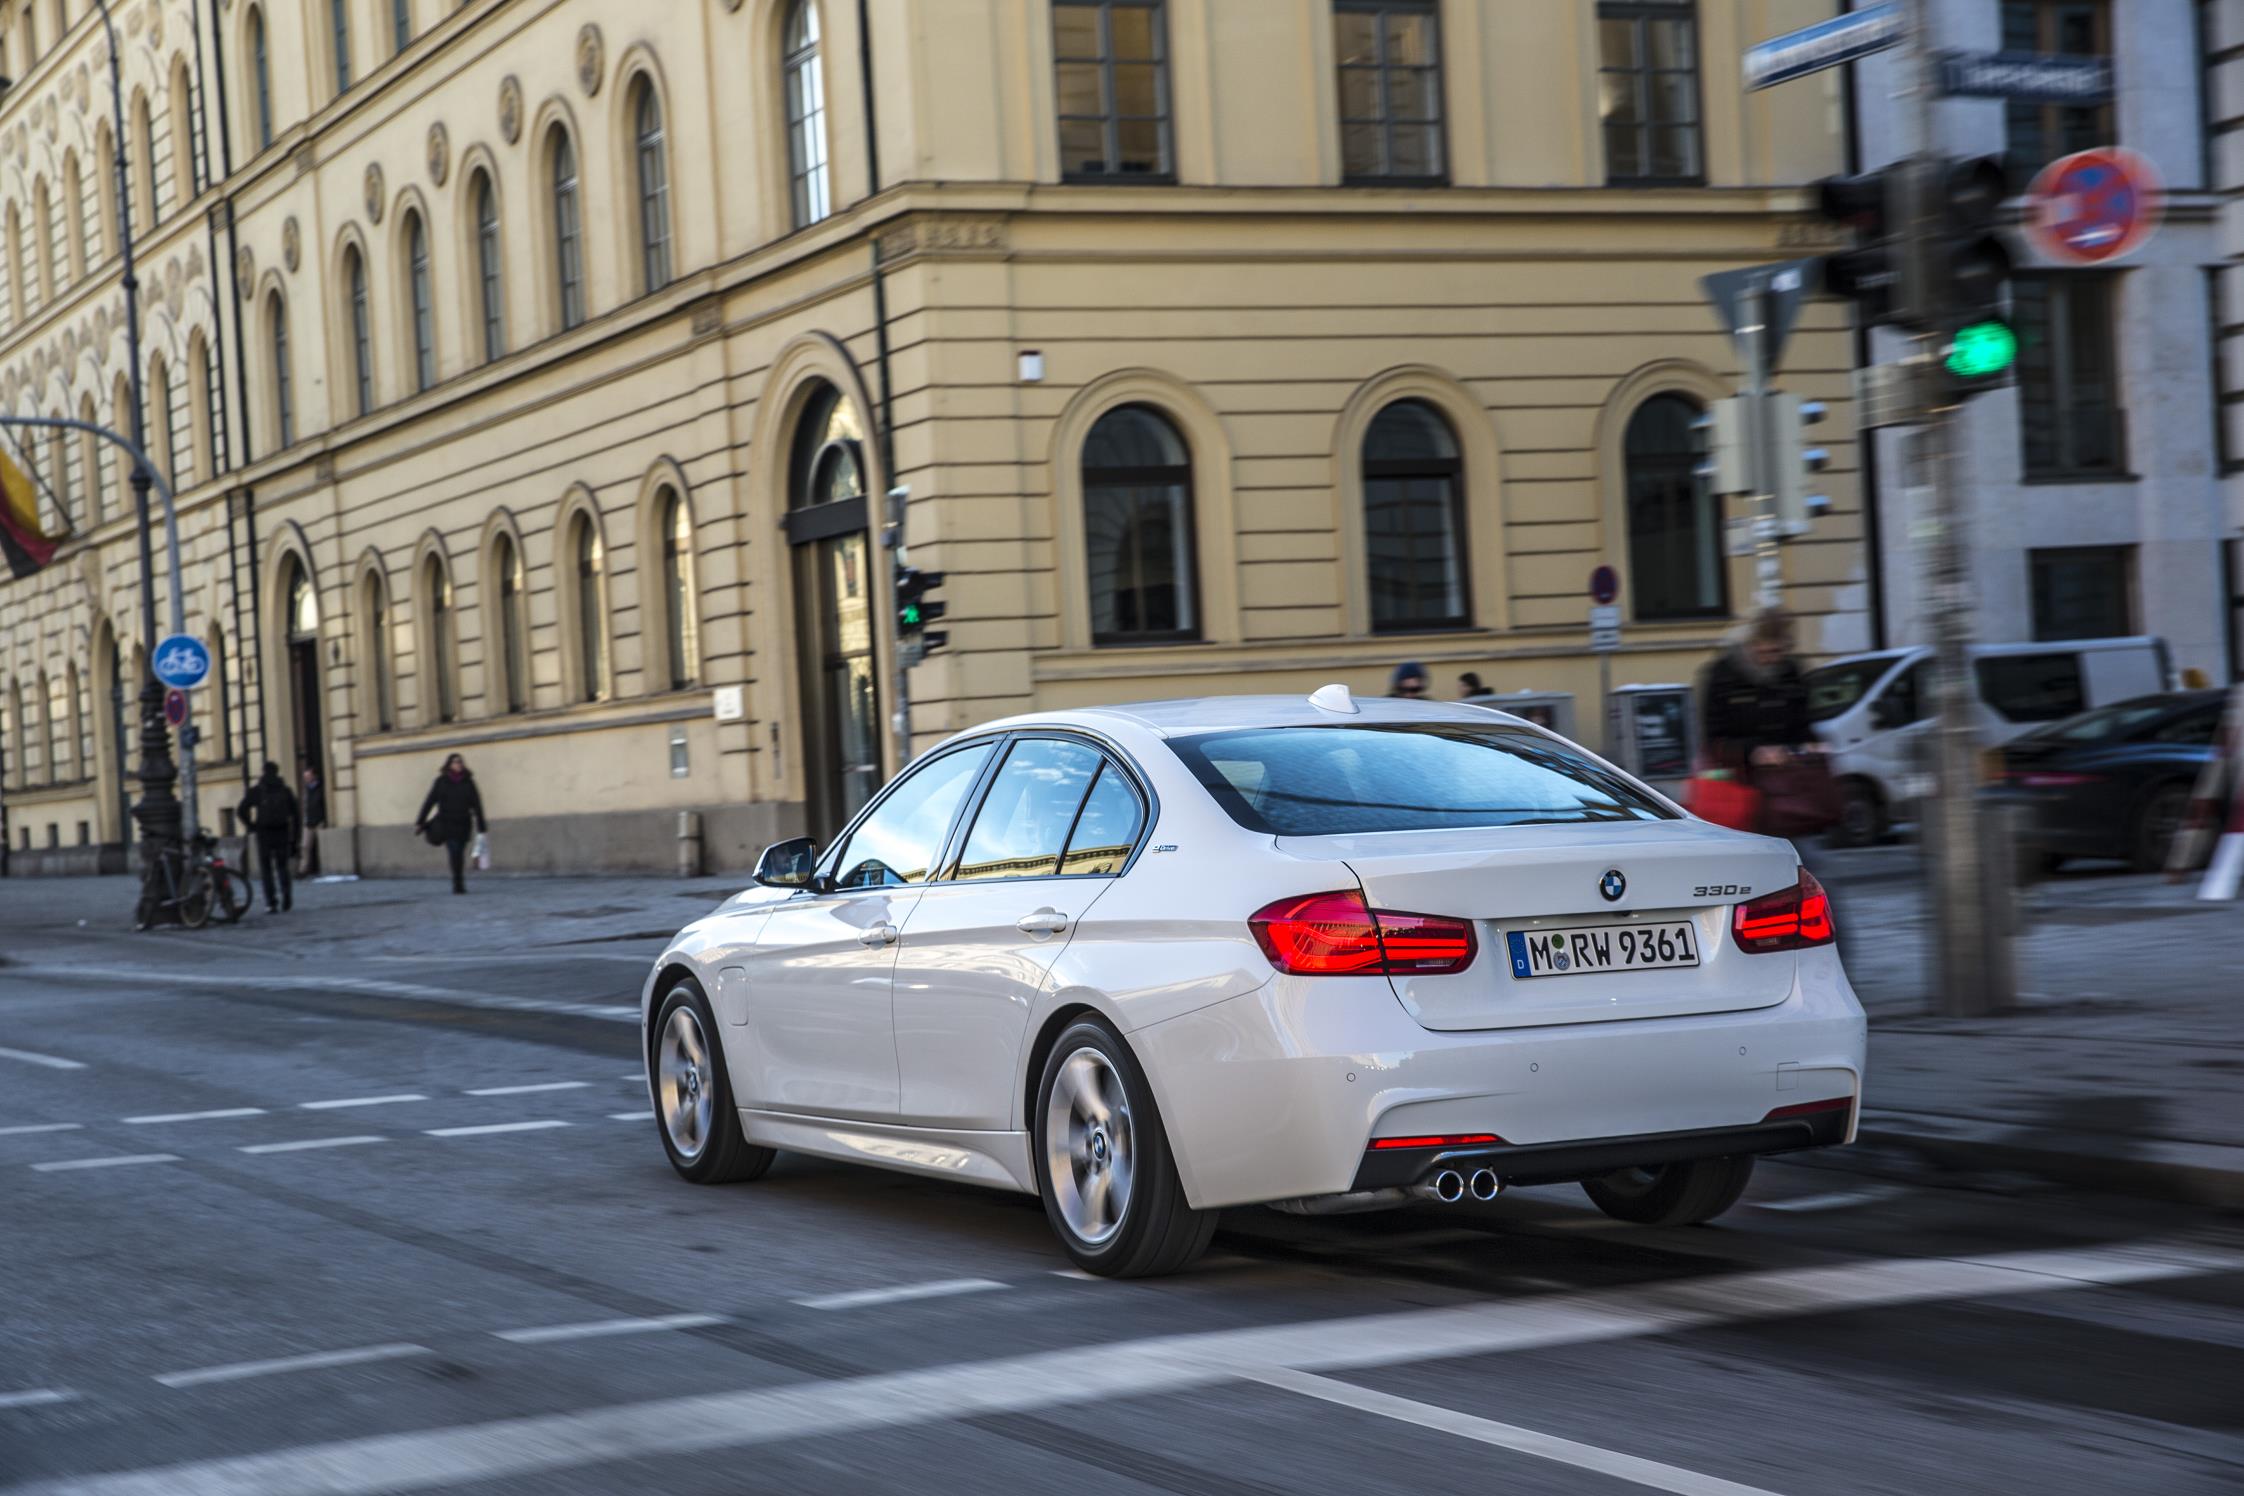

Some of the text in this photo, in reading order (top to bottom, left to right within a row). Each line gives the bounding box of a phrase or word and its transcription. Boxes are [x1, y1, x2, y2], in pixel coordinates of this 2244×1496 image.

[1693, 885, 1752, 897] 330e
[1529, 928, 1695, 970] M RW 9361
[1517, 959, 1525, 970] D
